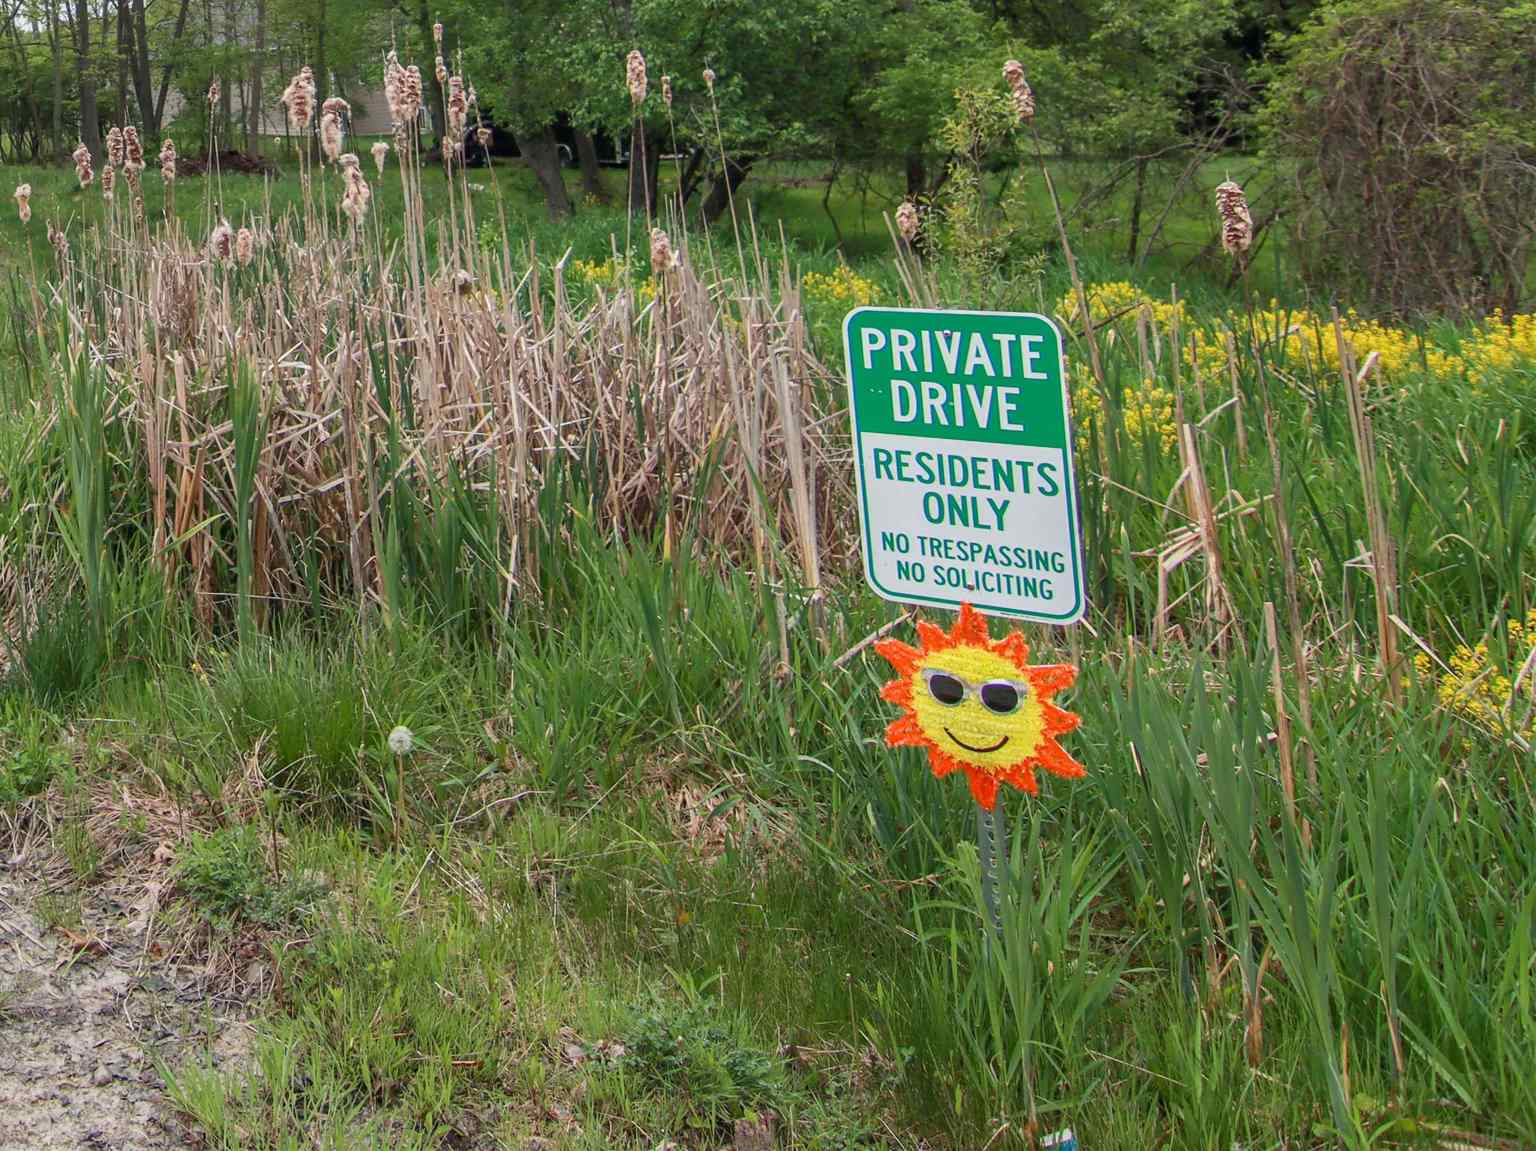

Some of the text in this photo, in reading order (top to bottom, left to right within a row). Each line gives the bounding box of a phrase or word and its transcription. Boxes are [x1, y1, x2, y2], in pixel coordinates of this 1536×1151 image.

[860, 327, 1048, 380] PRIVATE
[890, 379, 1024, 432] DRIVE
[872, 448, 1059, 497] RESIDENTS
[923, 491, 1010, 531] ONLY
[881, 531, 1065, 574] NO TRESPASSING
[896, 560, 1053, 600] NO SOLICITING
